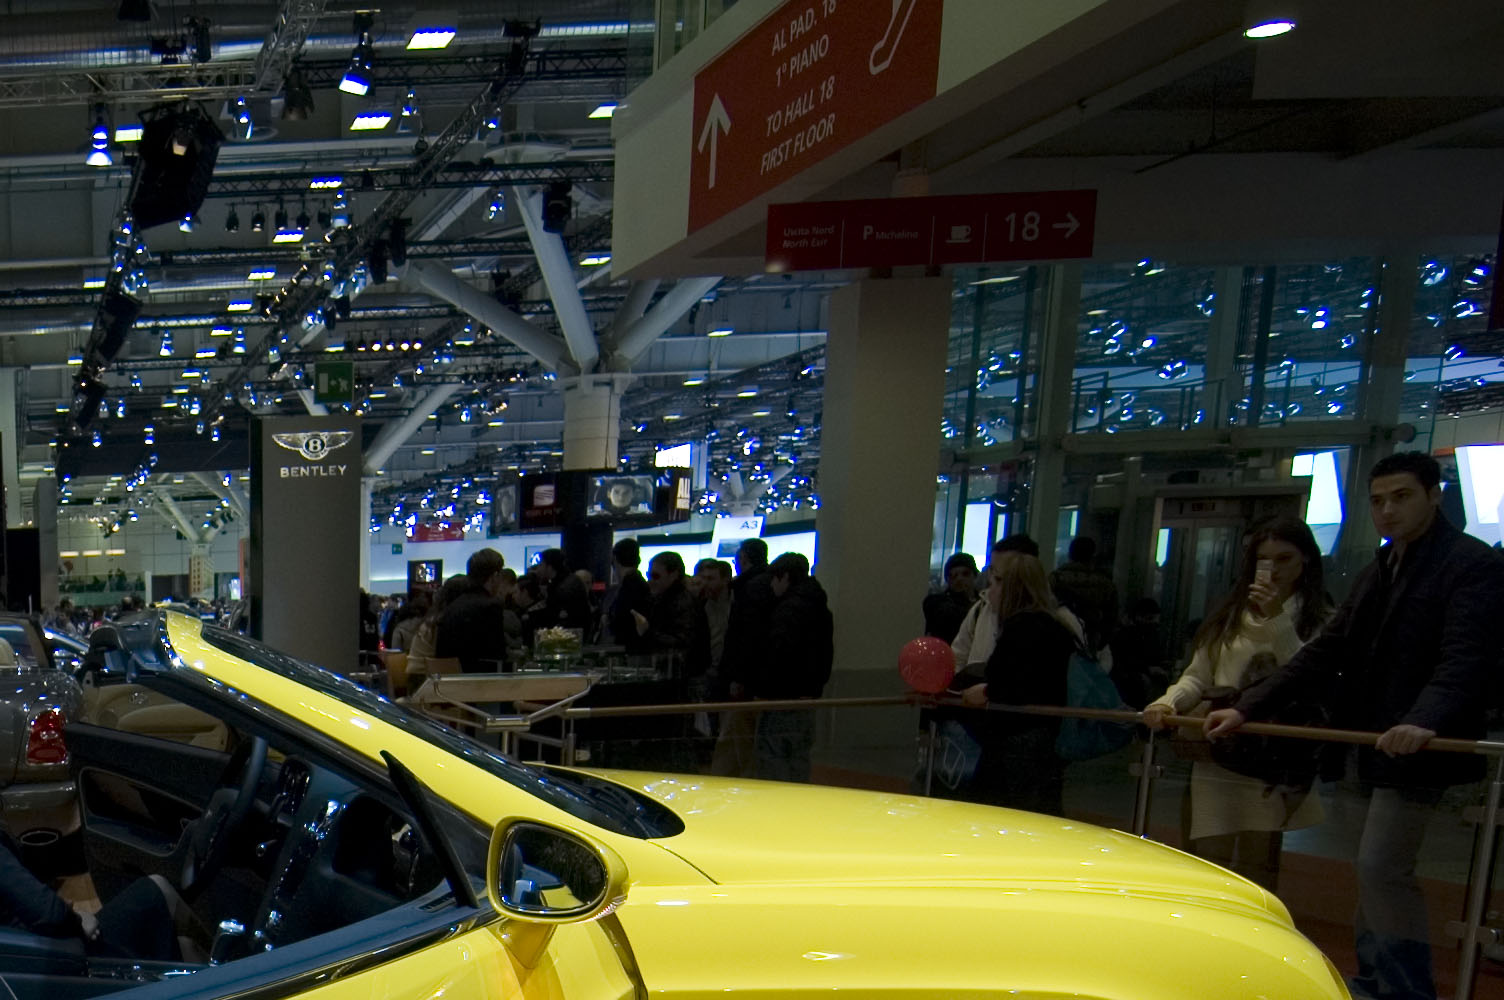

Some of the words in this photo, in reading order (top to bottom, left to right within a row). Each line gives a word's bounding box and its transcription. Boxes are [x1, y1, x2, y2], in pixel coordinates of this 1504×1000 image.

[771, 28, 787, 56] AL
[790, 8, 817, 43] PAD.
[790, 34, 830, 79] PIANO
[766, 112, 782, 137] TO
[784, 88, 815, 127] HALL
[820, 75, 836, 104] 18
[760, 138, 793, 175] FIRST
[793, 113, 836, 153] FLOOR
[863, 225, 874, 240] P
[1003, 210, 1041, 243] 18
[782, 238, 809, 249] North
[810, 238, 828, 247] Exit
[280, 464, 347, 478] BENTLEY
[739, 520, 758, 530] A3
